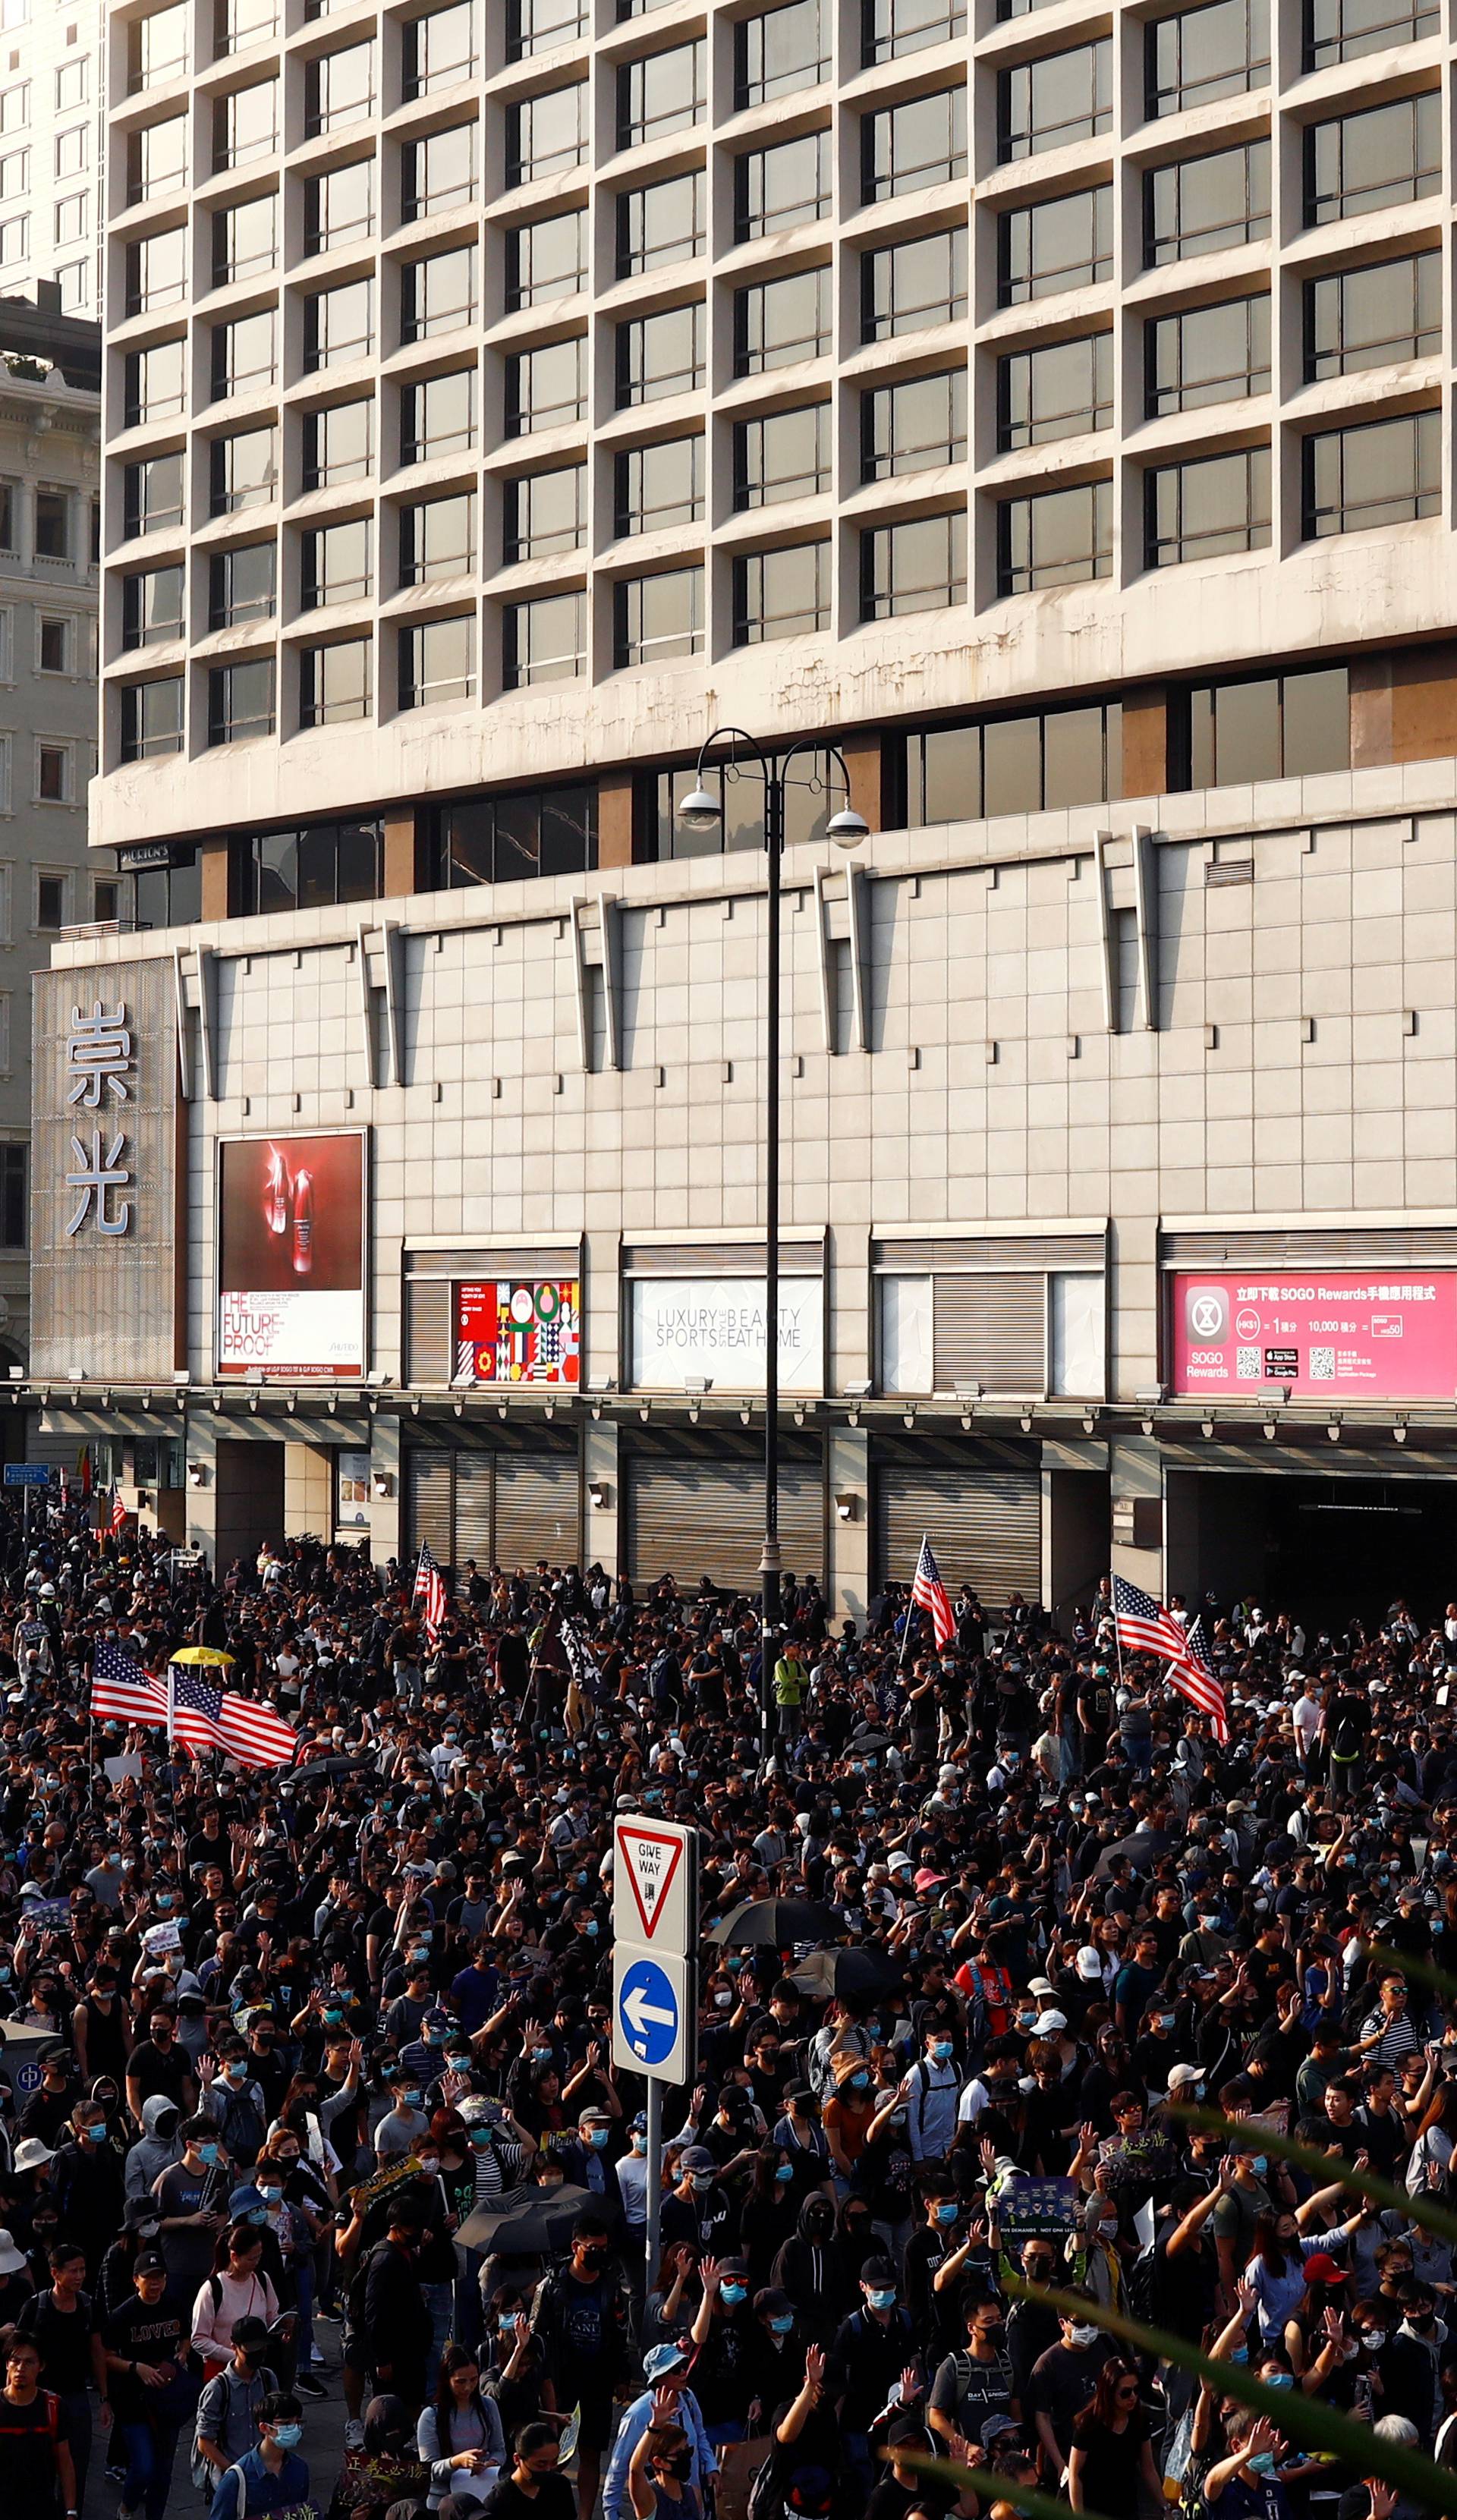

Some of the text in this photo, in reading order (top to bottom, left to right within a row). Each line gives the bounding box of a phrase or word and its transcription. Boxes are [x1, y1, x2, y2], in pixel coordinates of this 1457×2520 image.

[66, 999, 131, 1236] 崇光
[221, 1291, 248, 1313] THE
[1280, 1288, 1315, 1301] SOGO
[223, 1313, 280, 1334] FUTURE
[657, 1308, 801, 1328] LUXURY BEATY
[1238, 1320, 1257, 1330] HK$1
[1308, 1320, 1339, 1333] 10,000
[656, 1328, 717, 1347] SPORTS
[756, 1329, 801, 1348] HME
[719, 1310, 727, 1347] STYLE
[223, 1335, 275, 1356] PROOF
[1191, 1351, 1224, 1364] SOGO
[1186, 1365, 1229, 1378] Rewards
[638, 1842, 662, 1860] GIVE
[638, 1859, 661, 1876] WAY
